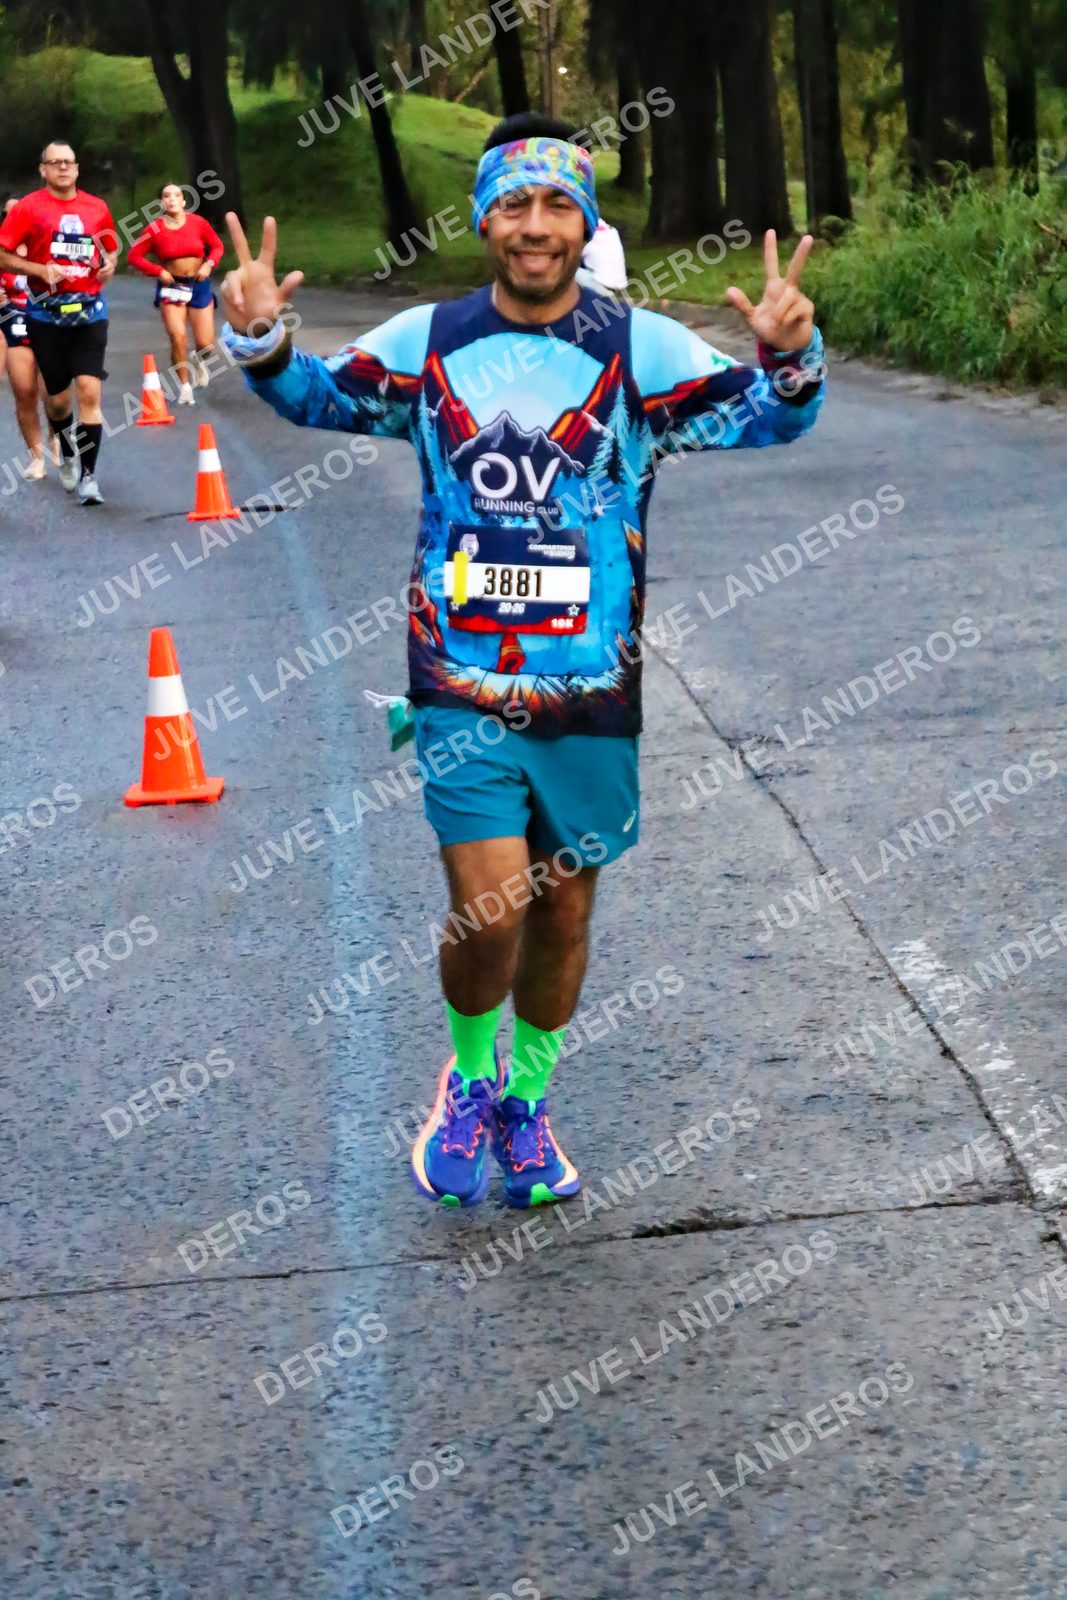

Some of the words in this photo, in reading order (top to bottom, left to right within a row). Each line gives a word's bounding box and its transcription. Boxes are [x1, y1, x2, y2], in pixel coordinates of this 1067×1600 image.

[472, 452, 561, 500] OV
[474, 498, 535, 513] RUNNING
[537, 506, 558, 515] CLUB
[484, 567, 542, 597] 3881
